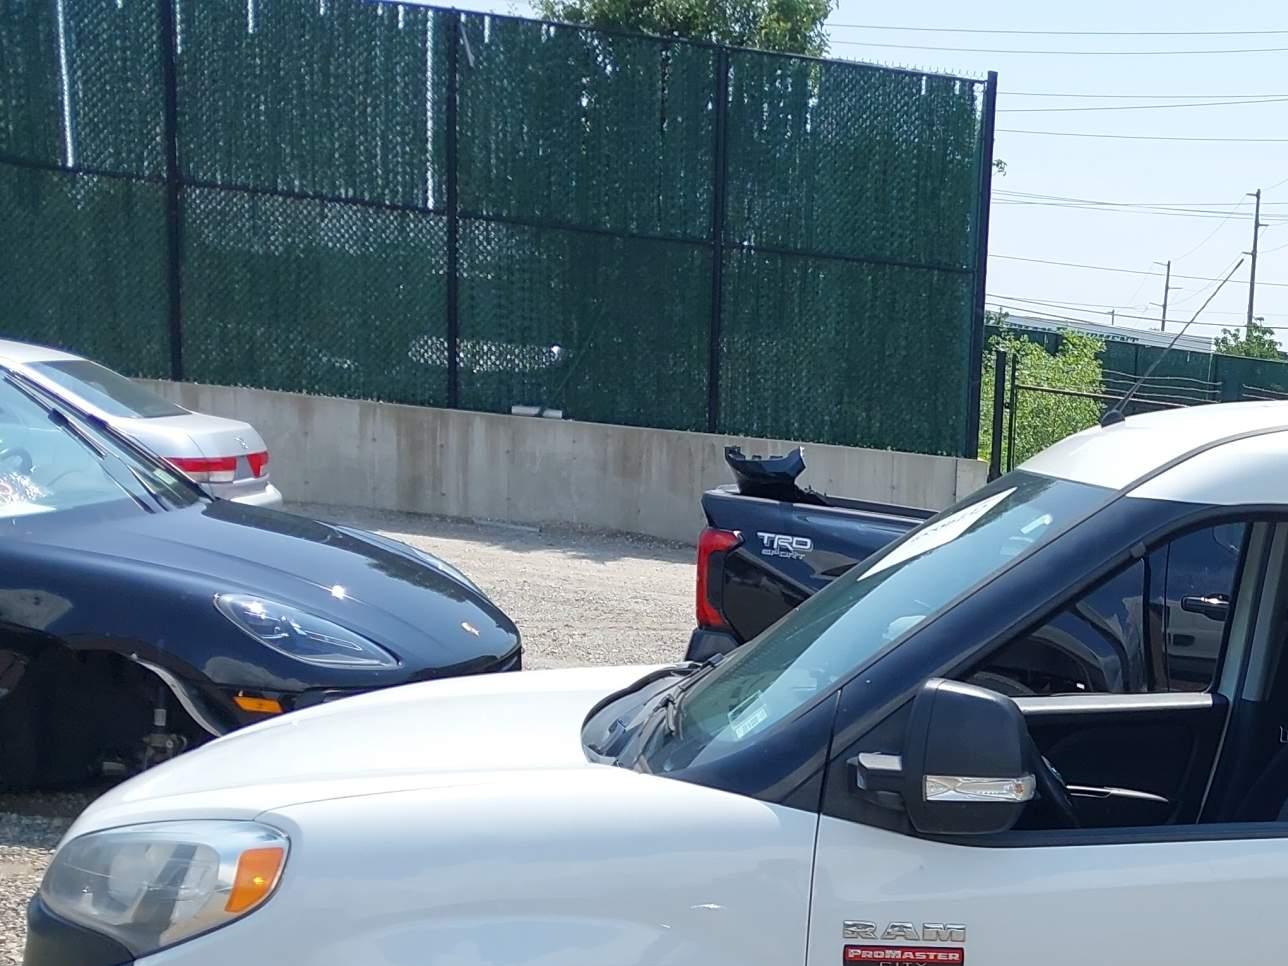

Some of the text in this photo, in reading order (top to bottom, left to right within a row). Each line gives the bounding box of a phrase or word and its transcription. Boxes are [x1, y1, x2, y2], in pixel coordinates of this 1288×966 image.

[757, 532, 813, 552] TRD
[761, 548, 806, 560] SPORT
[842, 920, 967, 942] RAM
